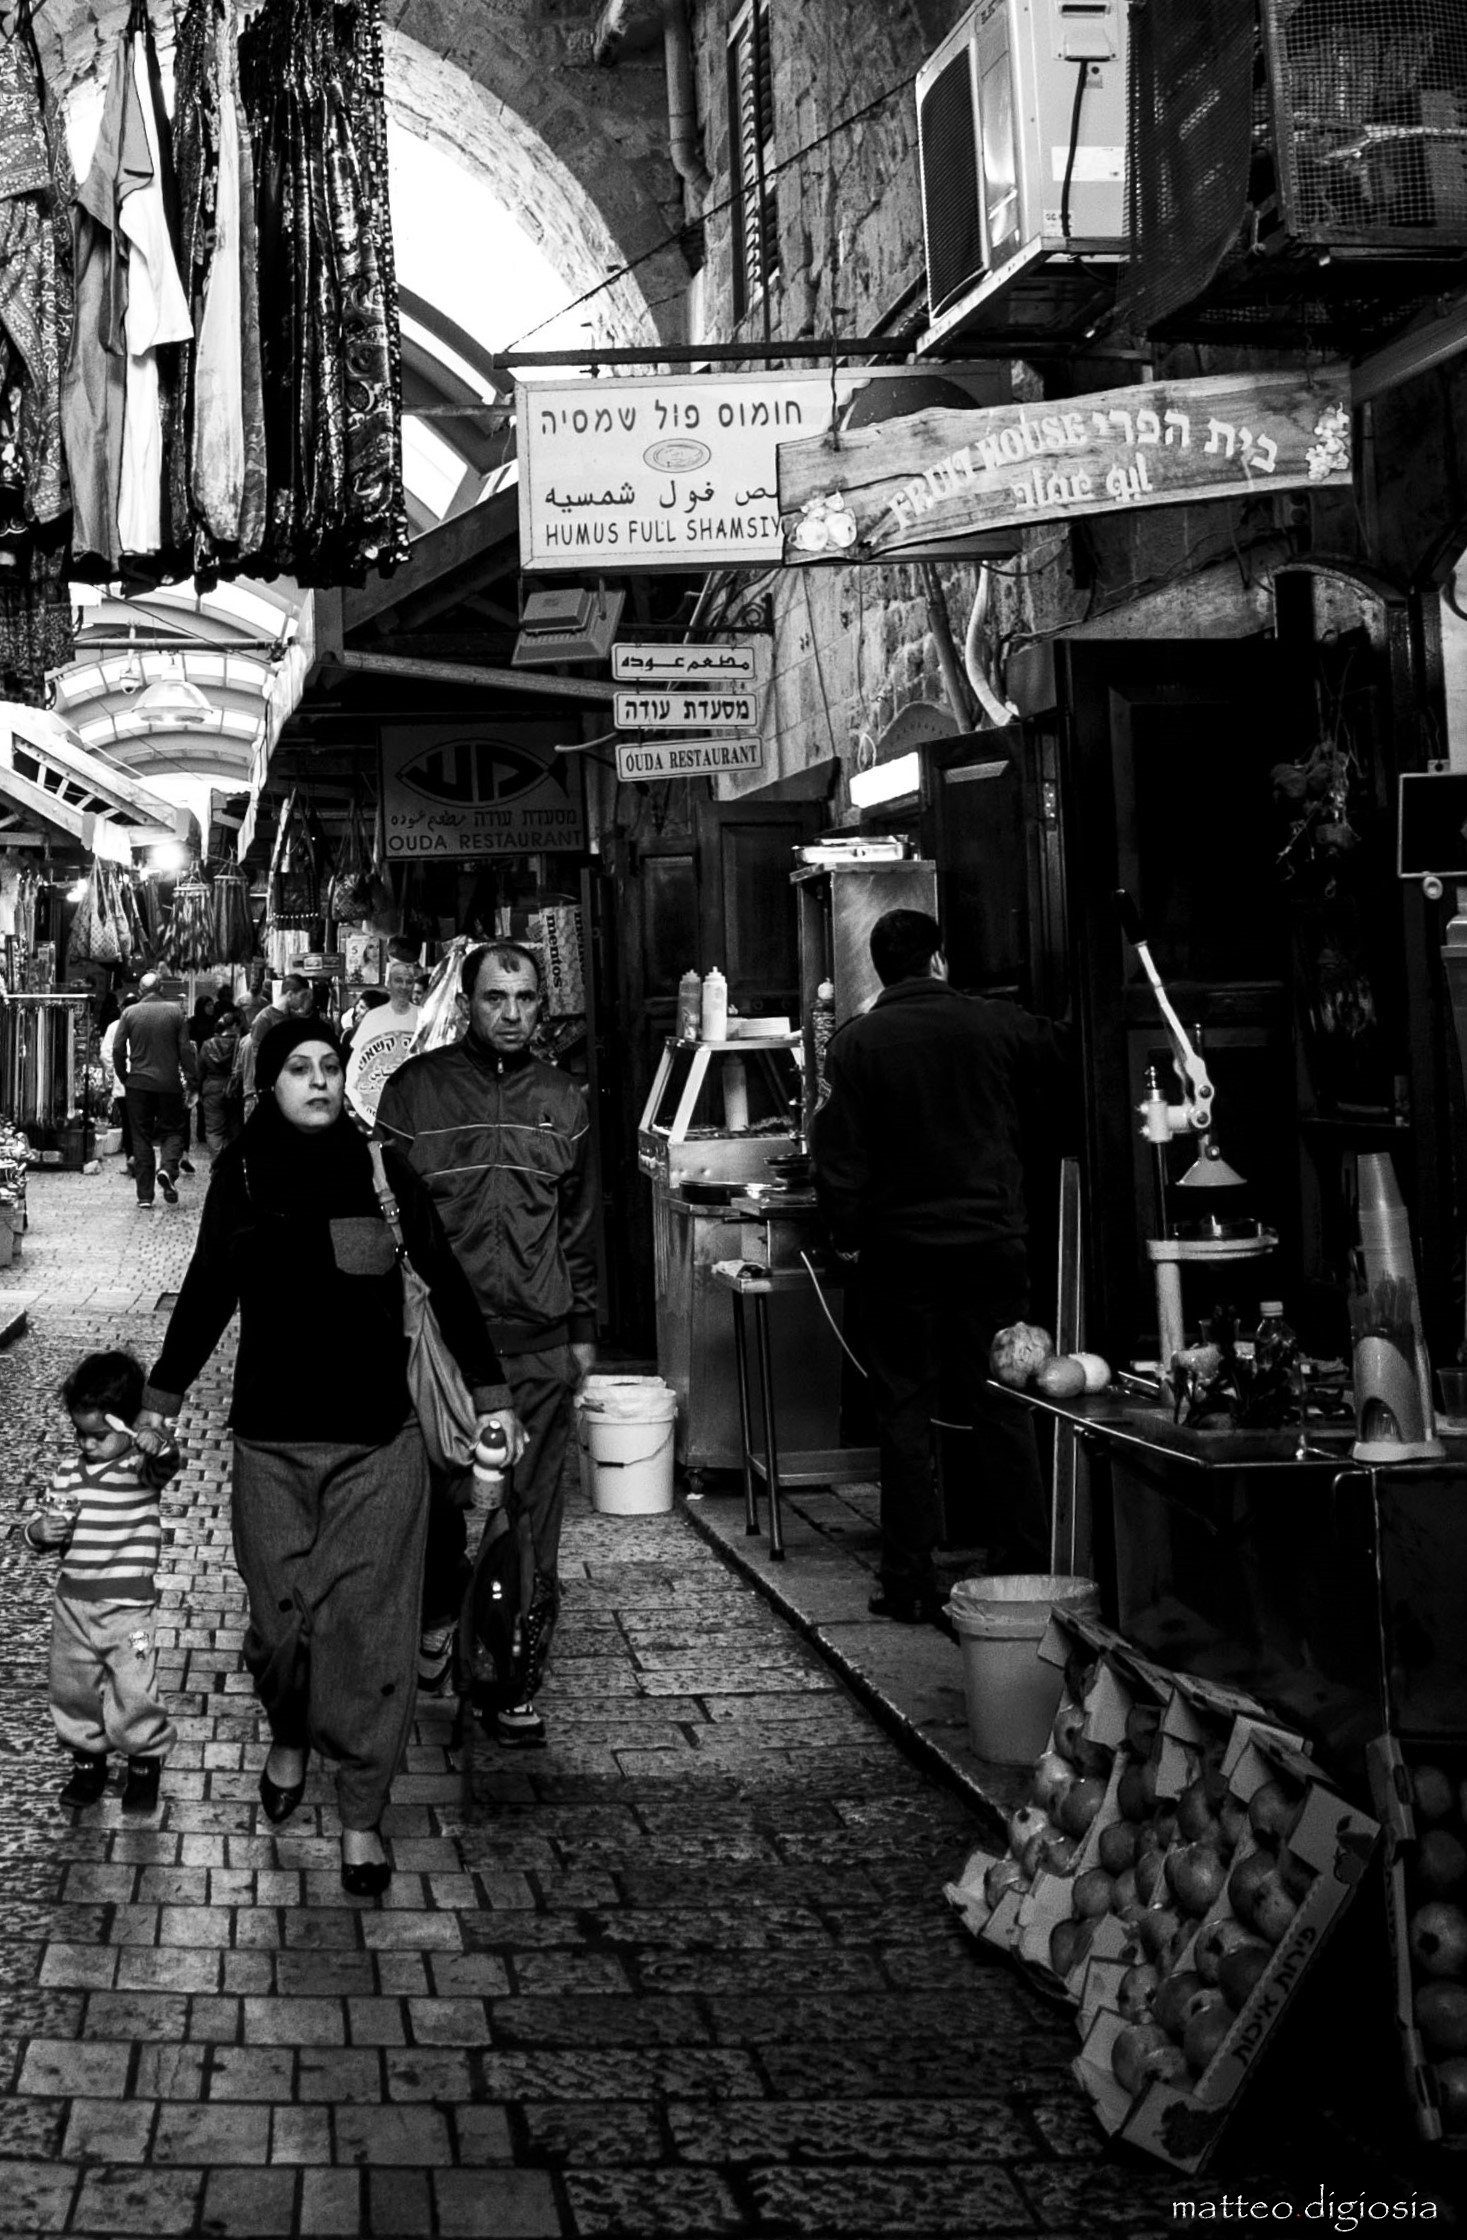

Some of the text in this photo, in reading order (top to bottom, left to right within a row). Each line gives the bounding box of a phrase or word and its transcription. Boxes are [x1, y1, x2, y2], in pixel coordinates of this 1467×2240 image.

[541, 398, 802, 434] חומוס פול שמסיה
[975, 412, 1088, 468] HOUSE
[1092, 408, 1278, 473] הפרי בית
[659, 480, 715, 513] فول
[546, 522, 619, 547] HUMUS
[628, 519, 676, 543] FULL
[687, 655, 750, 672] مطعم
[625, 700, 750, 720] מסעדת עודה
[625, 745, 757, 772] OUDA RESTAURANT
[474, 809, 576, 827] מסעדת עודה
[388, 830, 581, 851] OUDA RESTAURANT
[546, 914, 562, 988] mentos
[1231, 1927, 1316, 2067] פירות איכות
